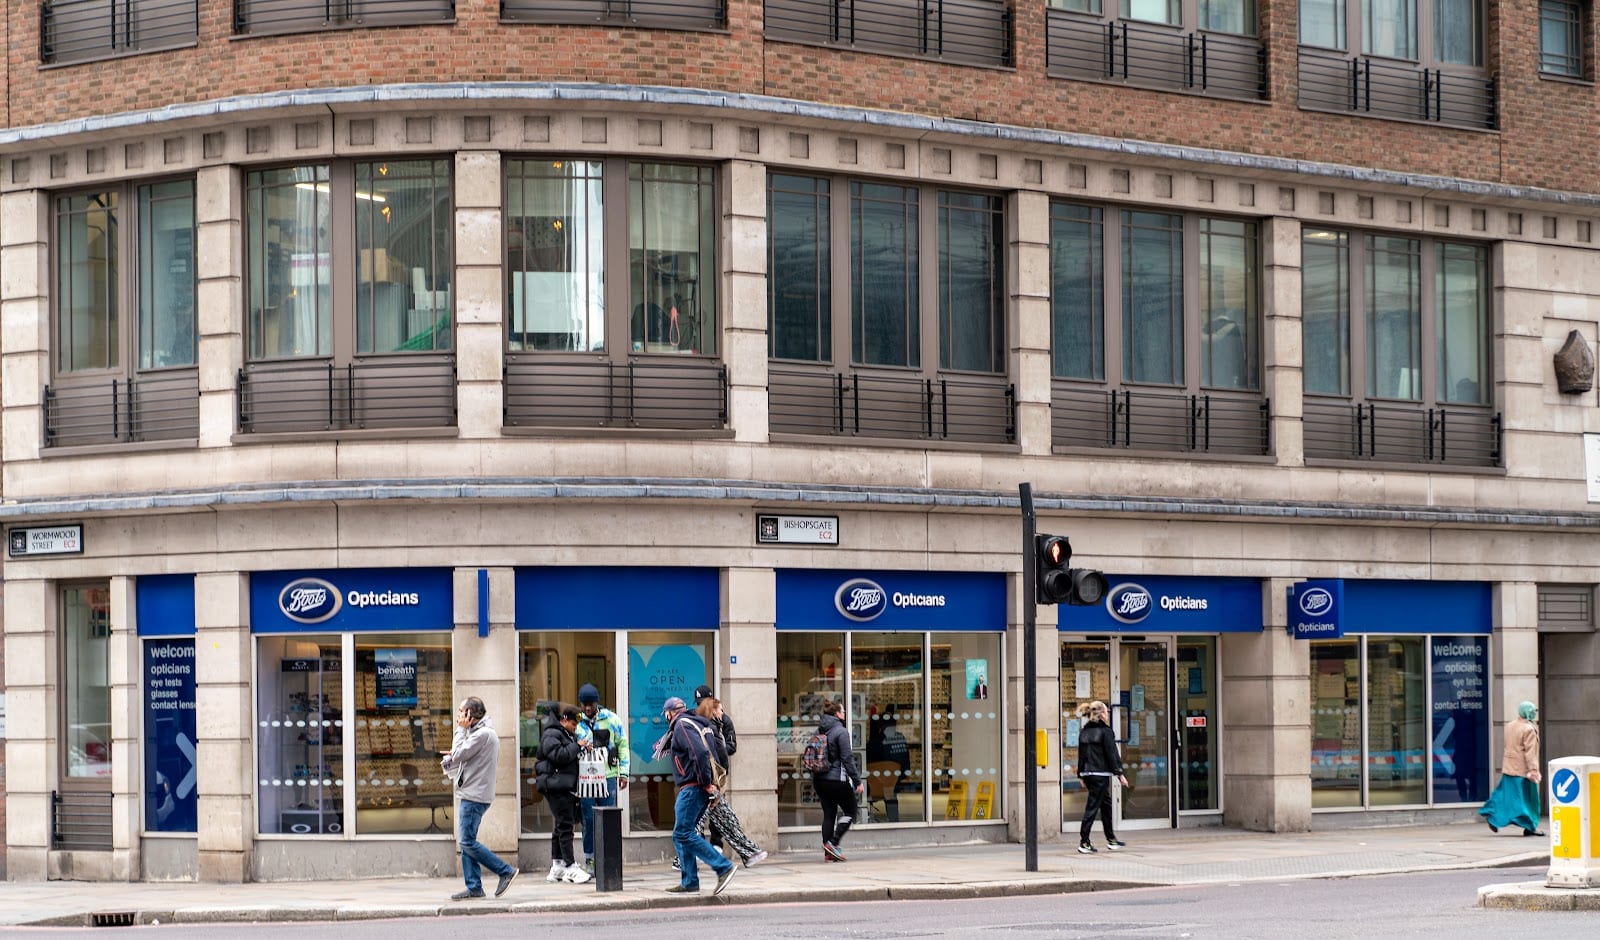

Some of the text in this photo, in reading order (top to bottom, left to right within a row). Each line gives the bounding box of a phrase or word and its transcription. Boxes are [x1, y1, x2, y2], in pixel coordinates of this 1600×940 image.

[784, 519, 832, 530] BISHOPSGATE
[31, 529, 76, 541] WORMWOOD
[819, 530, 833, 540] EC2
[31, 540, 76, 551] STREET EC2
[286, 587, 419, 613] Boots Opticians
[846, 587, 946, 611] Boots Opticians
[1117, 592, 1208, 614] Boots Opticians
[1304, 594, 1328, 610] Boots
[1298, 622, 1335, 633] Opticians
[1434, 642, 1482, 656] welcome
[151, 664, 190, 676] opticians
[377, 665, 415, 675] beneath
[1445, 662, 1482, 674] opticians
[151, 678, 182, 688] eye tests
[649, 676, 685, 684] OPEN
[1453, 679, 1464, 688] eye
[151, 690, 178, 700] glasses
[1457, 690, 1482, 699] glasses
[151, 700, 178, 709] contact
[1434, 701, 1482, 710] contact lenses
